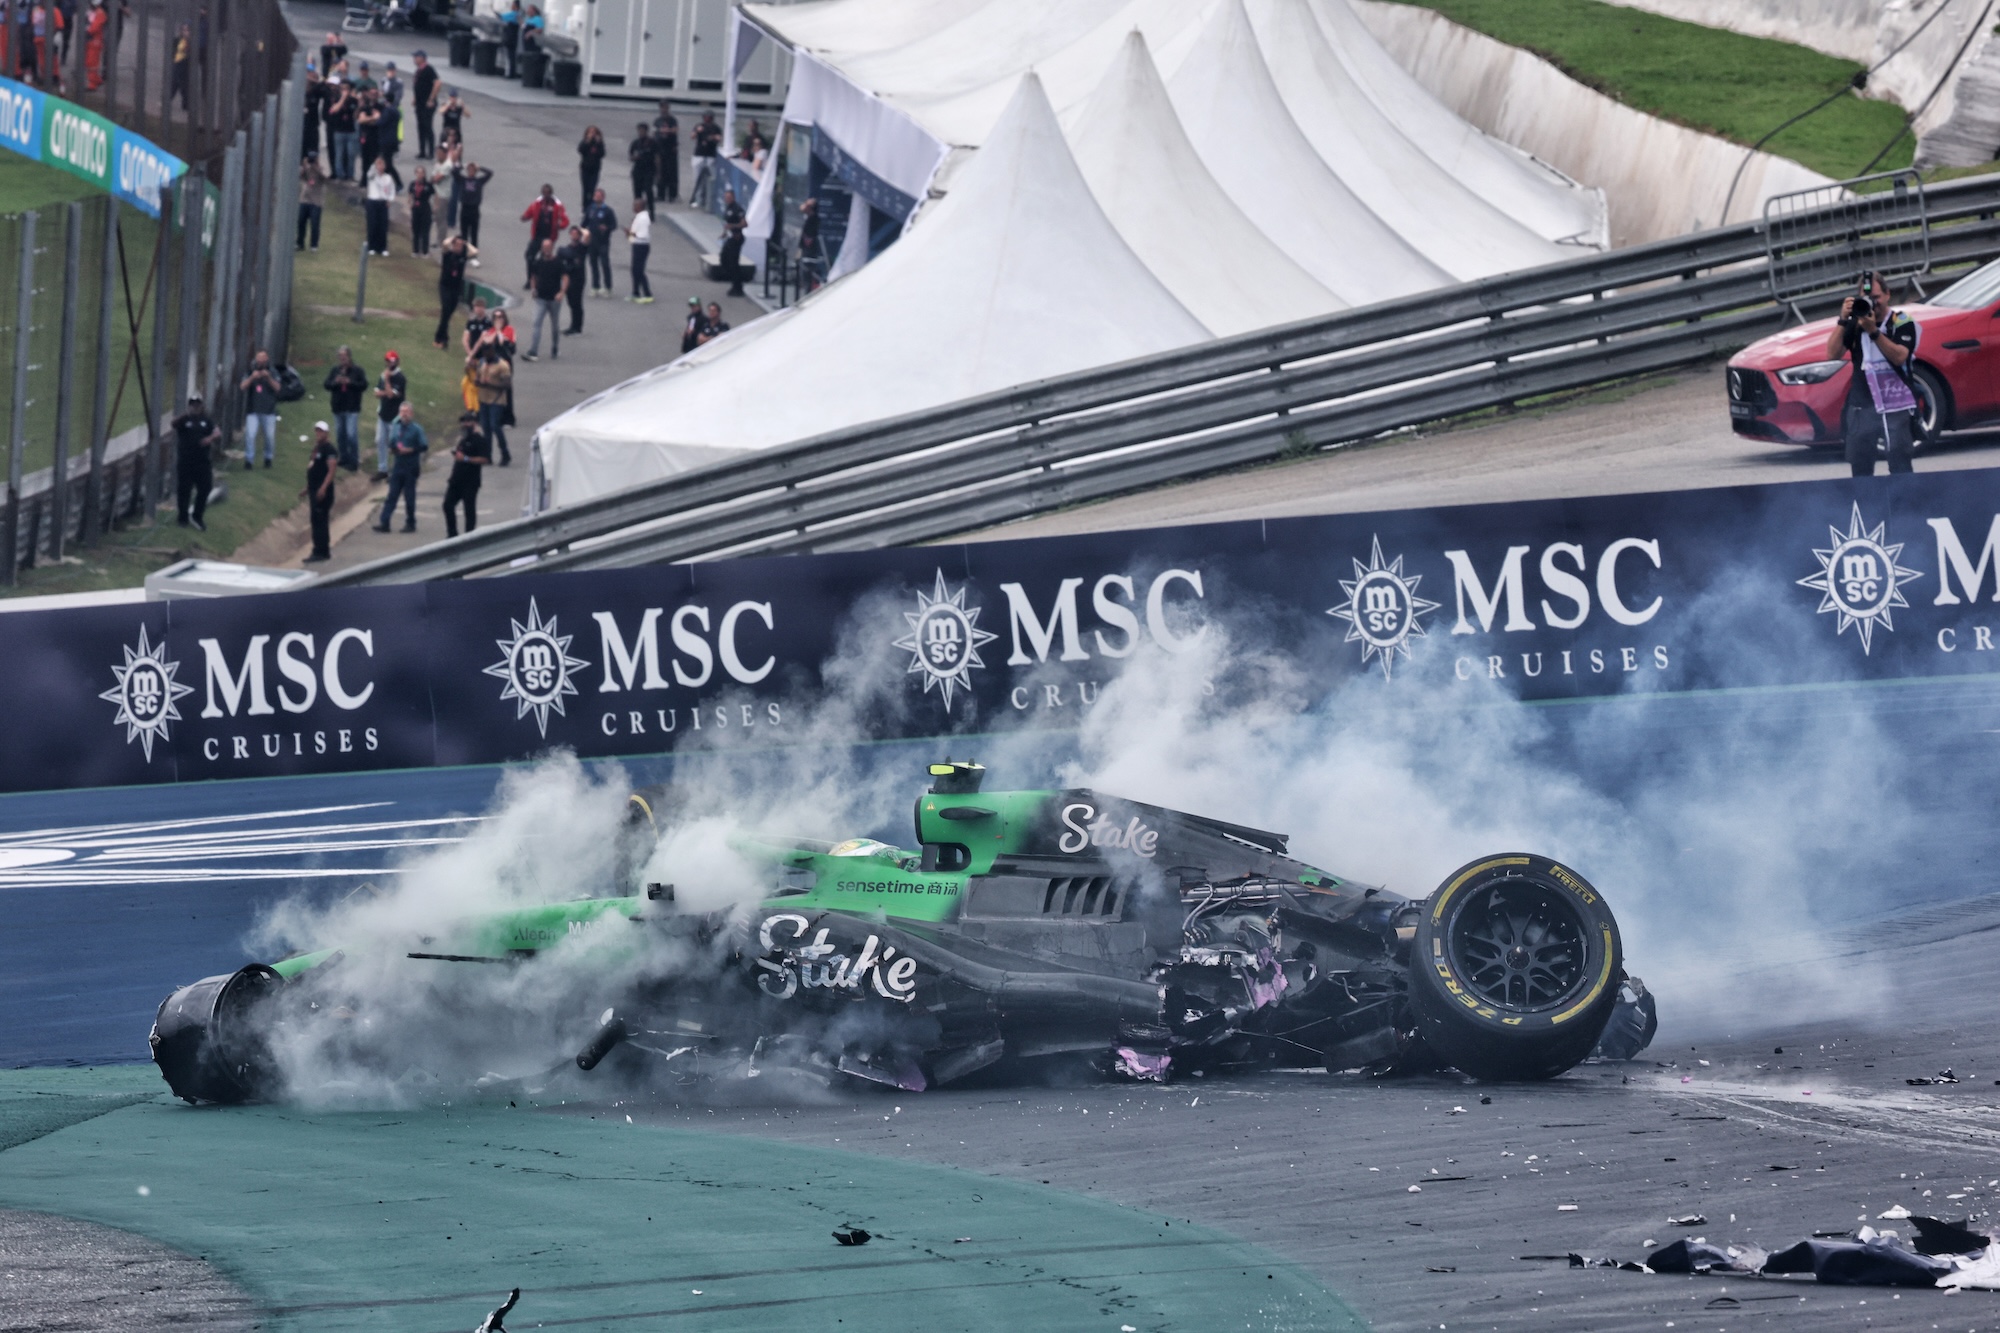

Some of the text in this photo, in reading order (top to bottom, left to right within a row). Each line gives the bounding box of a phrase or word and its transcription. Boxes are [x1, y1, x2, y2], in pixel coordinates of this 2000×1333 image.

[50, 108, 107, 178] aramco
[1444, 538, 1663, 634] MSC
[1000, 568, 1207, 666] MSC
[592, 600, 776, 692] MSC
[1455, 645, 1669, 681] CRUISES
[199, 627, 374, 719] MSC
[1011, 672, 1215, 710] CRUS
[602, 702, 781, 736] CRUISES
[204, 727, 379, 761] CRUISES
[1059, 803, 1159, 858] Stake
[836, 880, 925, 894] sensetime
[927, 881, 958, 896] 商汤
[514, 927, 556, 943] Aleph
[757, 914, 917, 1003] Stake
